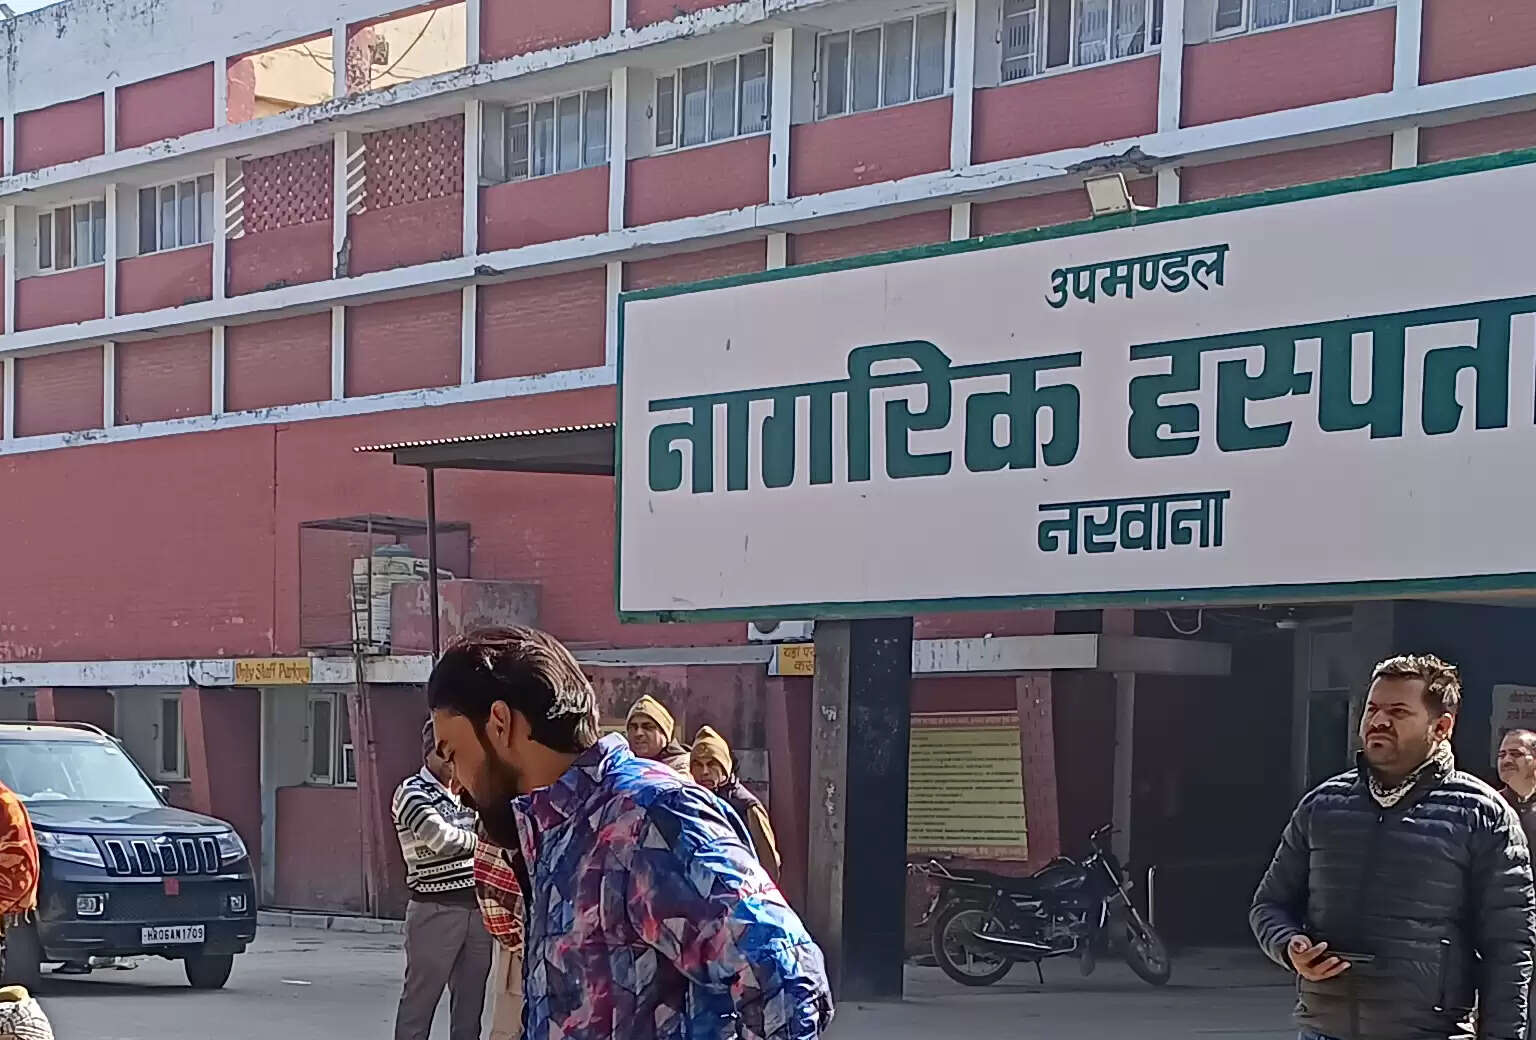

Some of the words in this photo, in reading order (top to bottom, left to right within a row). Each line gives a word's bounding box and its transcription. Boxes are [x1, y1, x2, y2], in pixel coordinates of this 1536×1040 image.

[1045, 243, 1230, 309] उपमण्डल
[648, 339, 1083, 494] नागरिक
[1037, 490, 1231, 556] नरवाना
